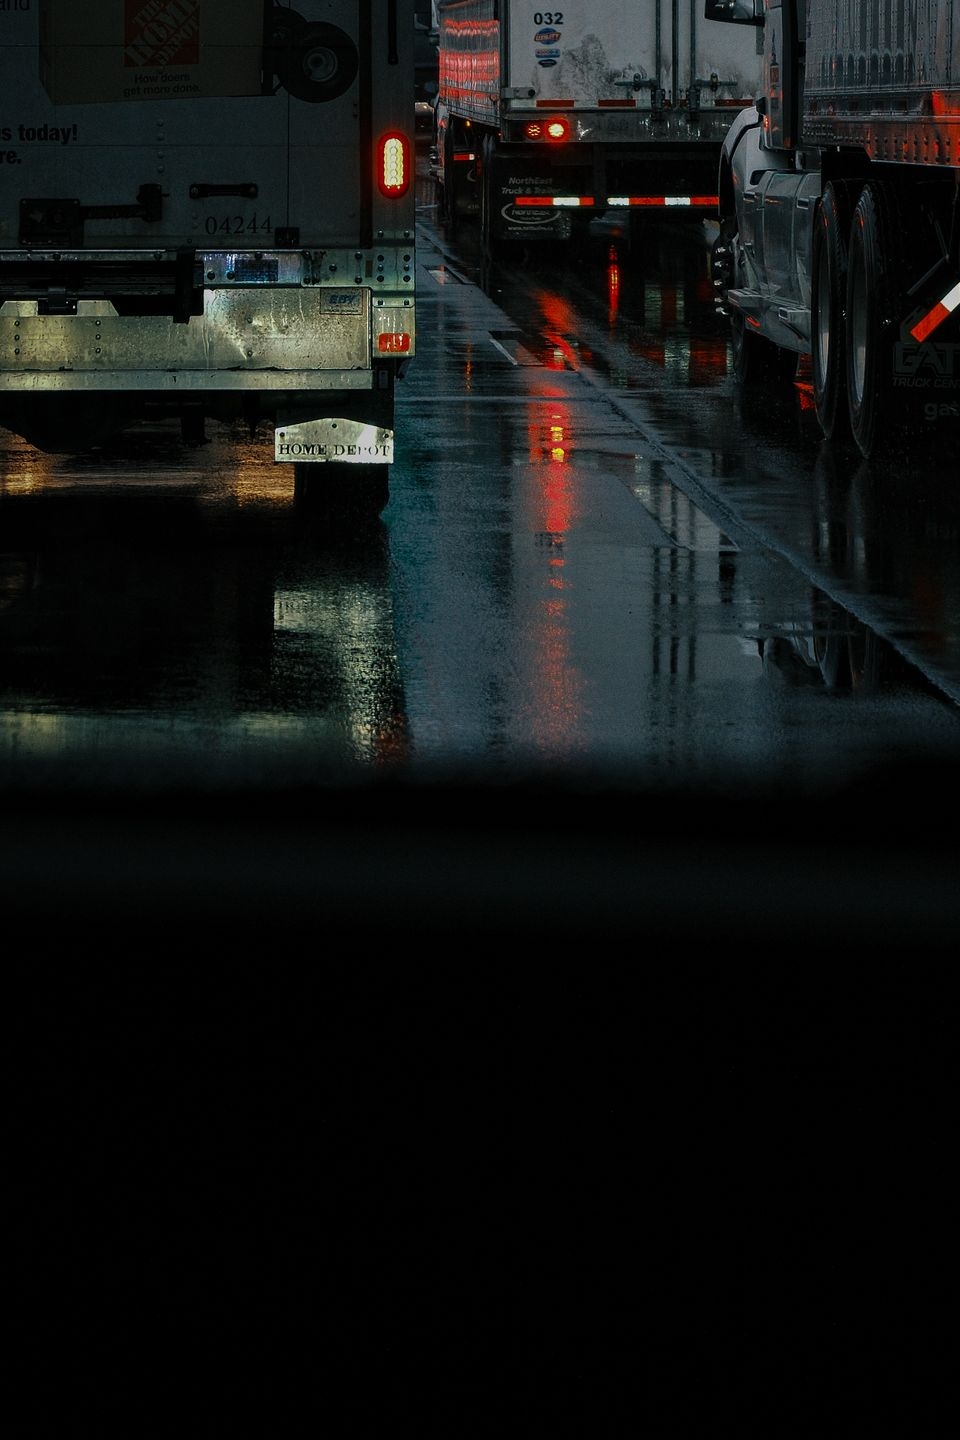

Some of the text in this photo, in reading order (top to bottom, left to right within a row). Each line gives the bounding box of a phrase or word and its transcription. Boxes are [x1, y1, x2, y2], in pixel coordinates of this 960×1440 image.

[534, 12, 563, 25] 032
[18, 123, 78, 145] today!
[205, 215, 273, 235] 04244
[890, 376, 933, 388] TRUCK
[278, 443, 327, 455] HOME
